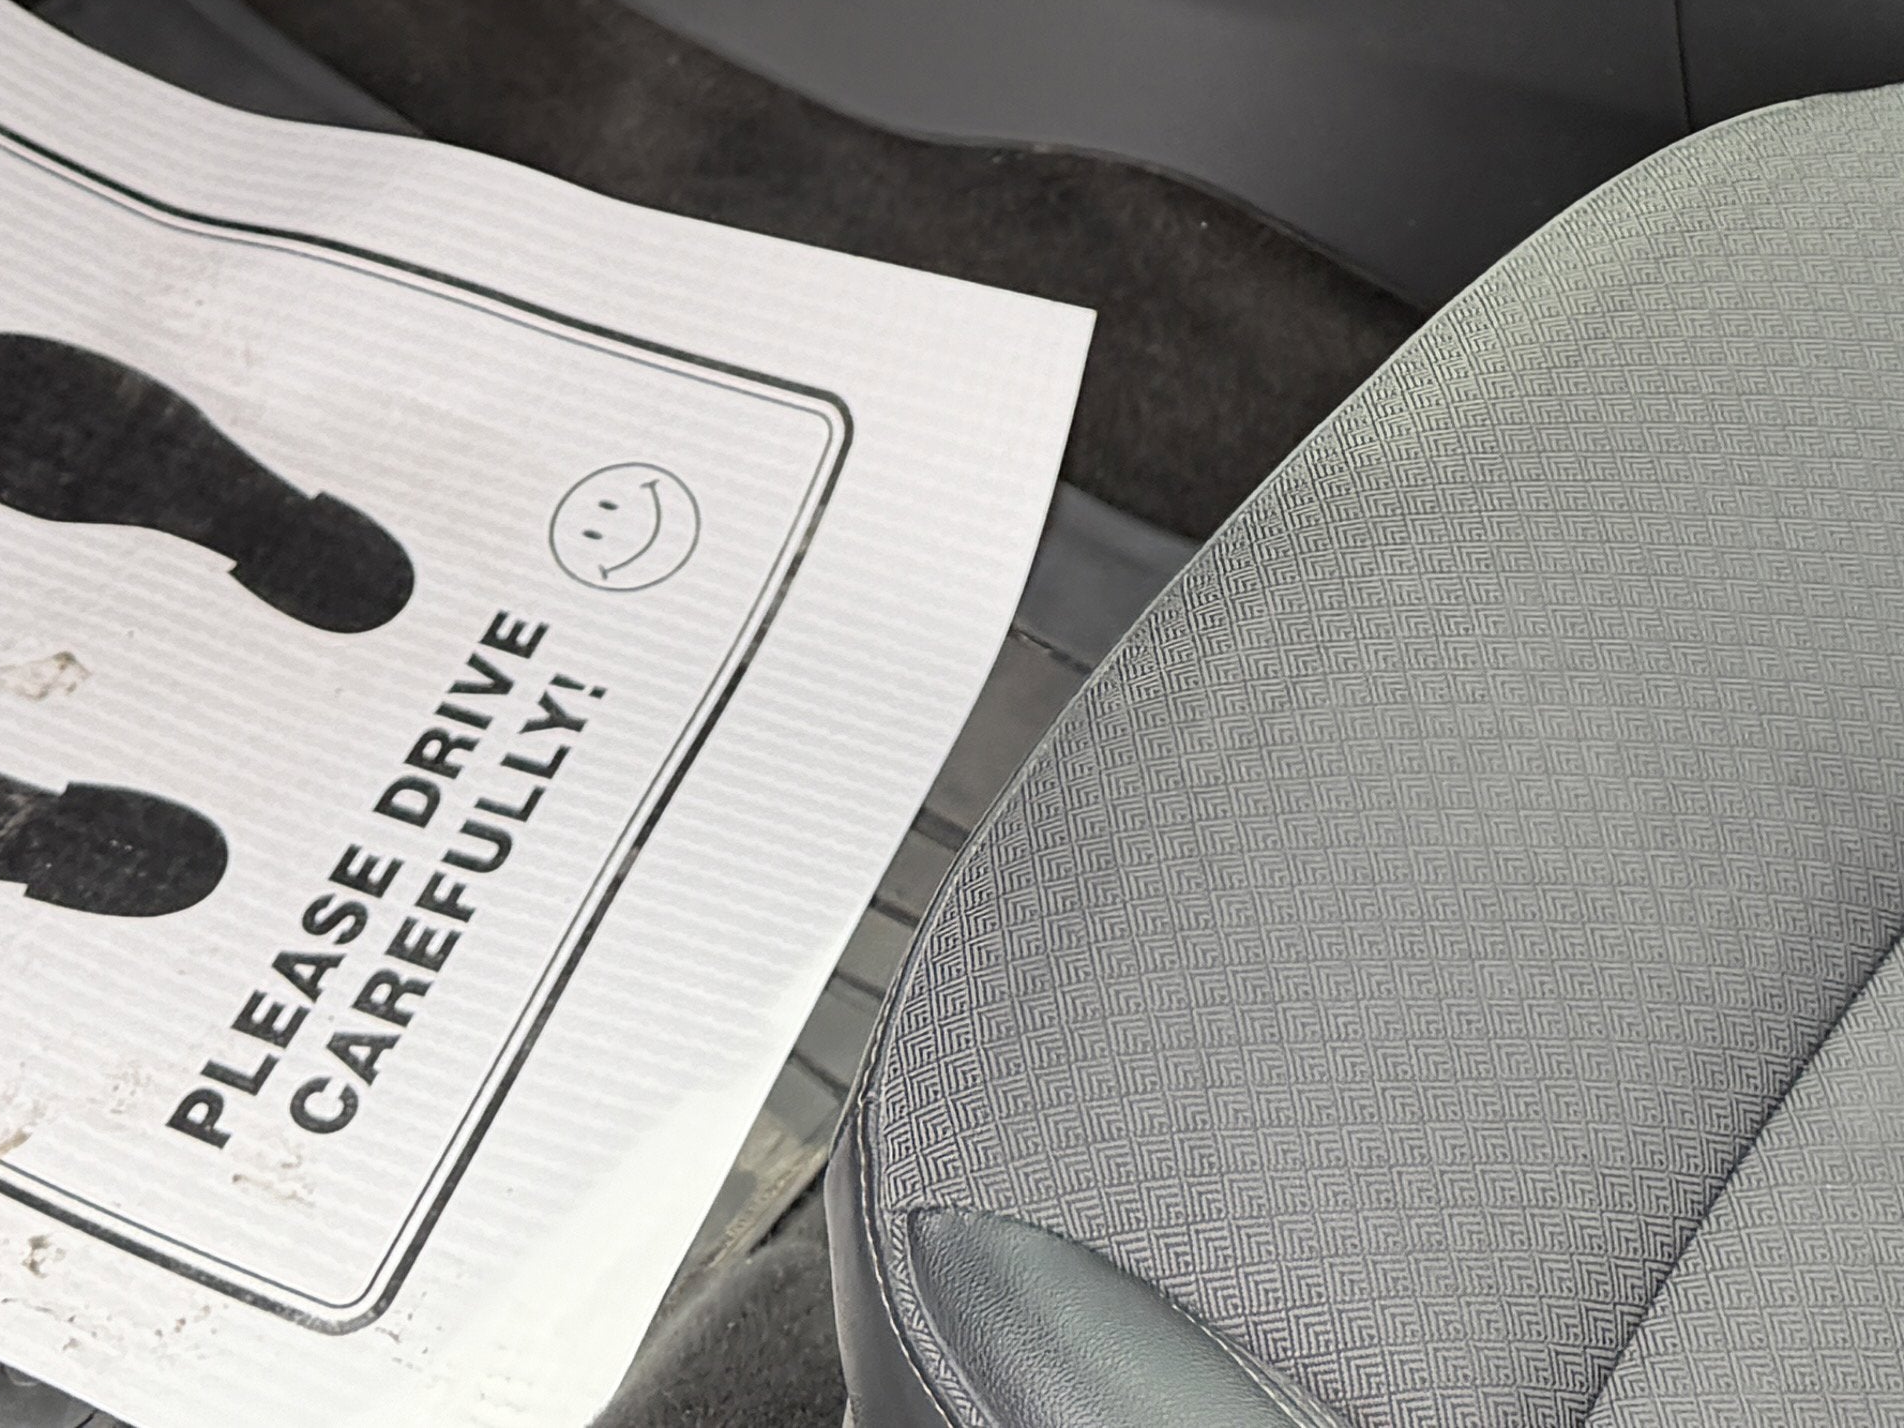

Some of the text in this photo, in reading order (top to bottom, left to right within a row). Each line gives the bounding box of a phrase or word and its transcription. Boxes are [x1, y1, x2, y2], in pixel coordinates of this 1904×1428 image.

[165, 608, 550, 1150] PLEASE DRIVE
[288, 672, 608, 1136] CAREFULLY!
